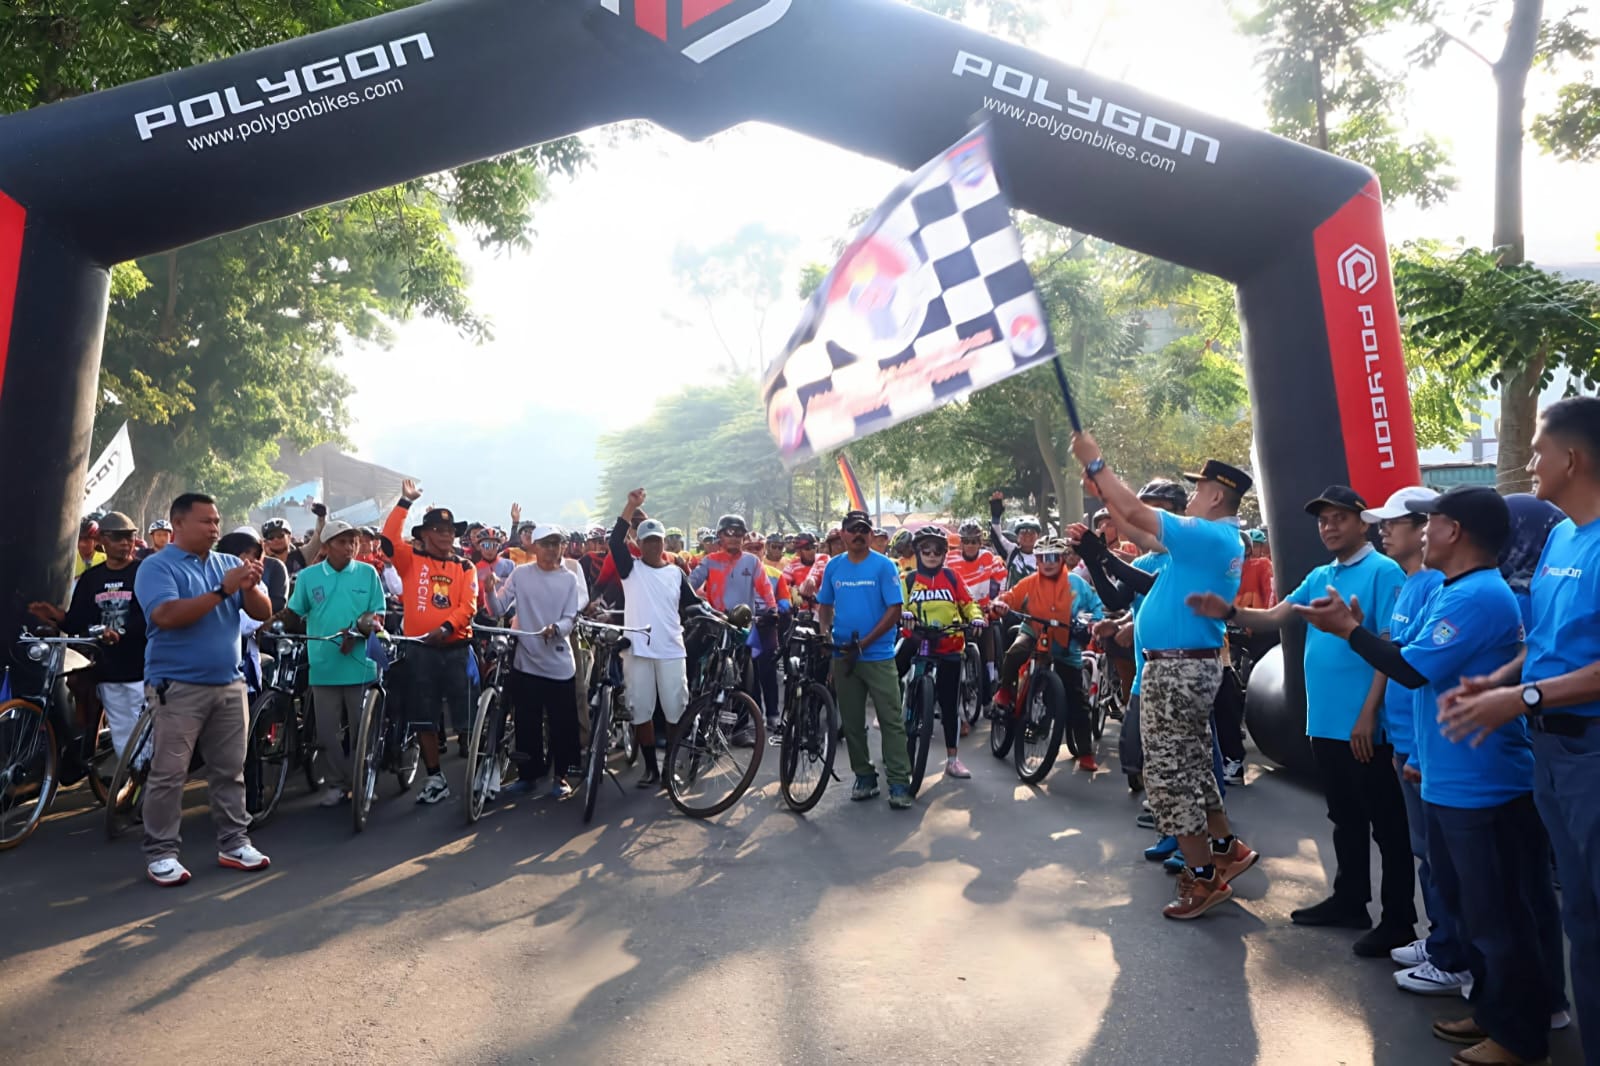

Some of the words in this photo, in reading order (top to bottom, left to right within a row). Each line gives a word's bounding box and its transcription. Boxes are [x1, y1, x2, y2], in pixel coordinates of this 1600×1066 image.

[134, 32, 435, 141] POLYGON
[187, 76, 404, 152] www.polygonbikes.com
[952, 50, 1221, 164] POLYGON
[983, 95, 1176, 173] www.polygonbikes.com
[1357, 304, 1395, 469] POLYGON
[909, 588, 954, 602] PADATI
